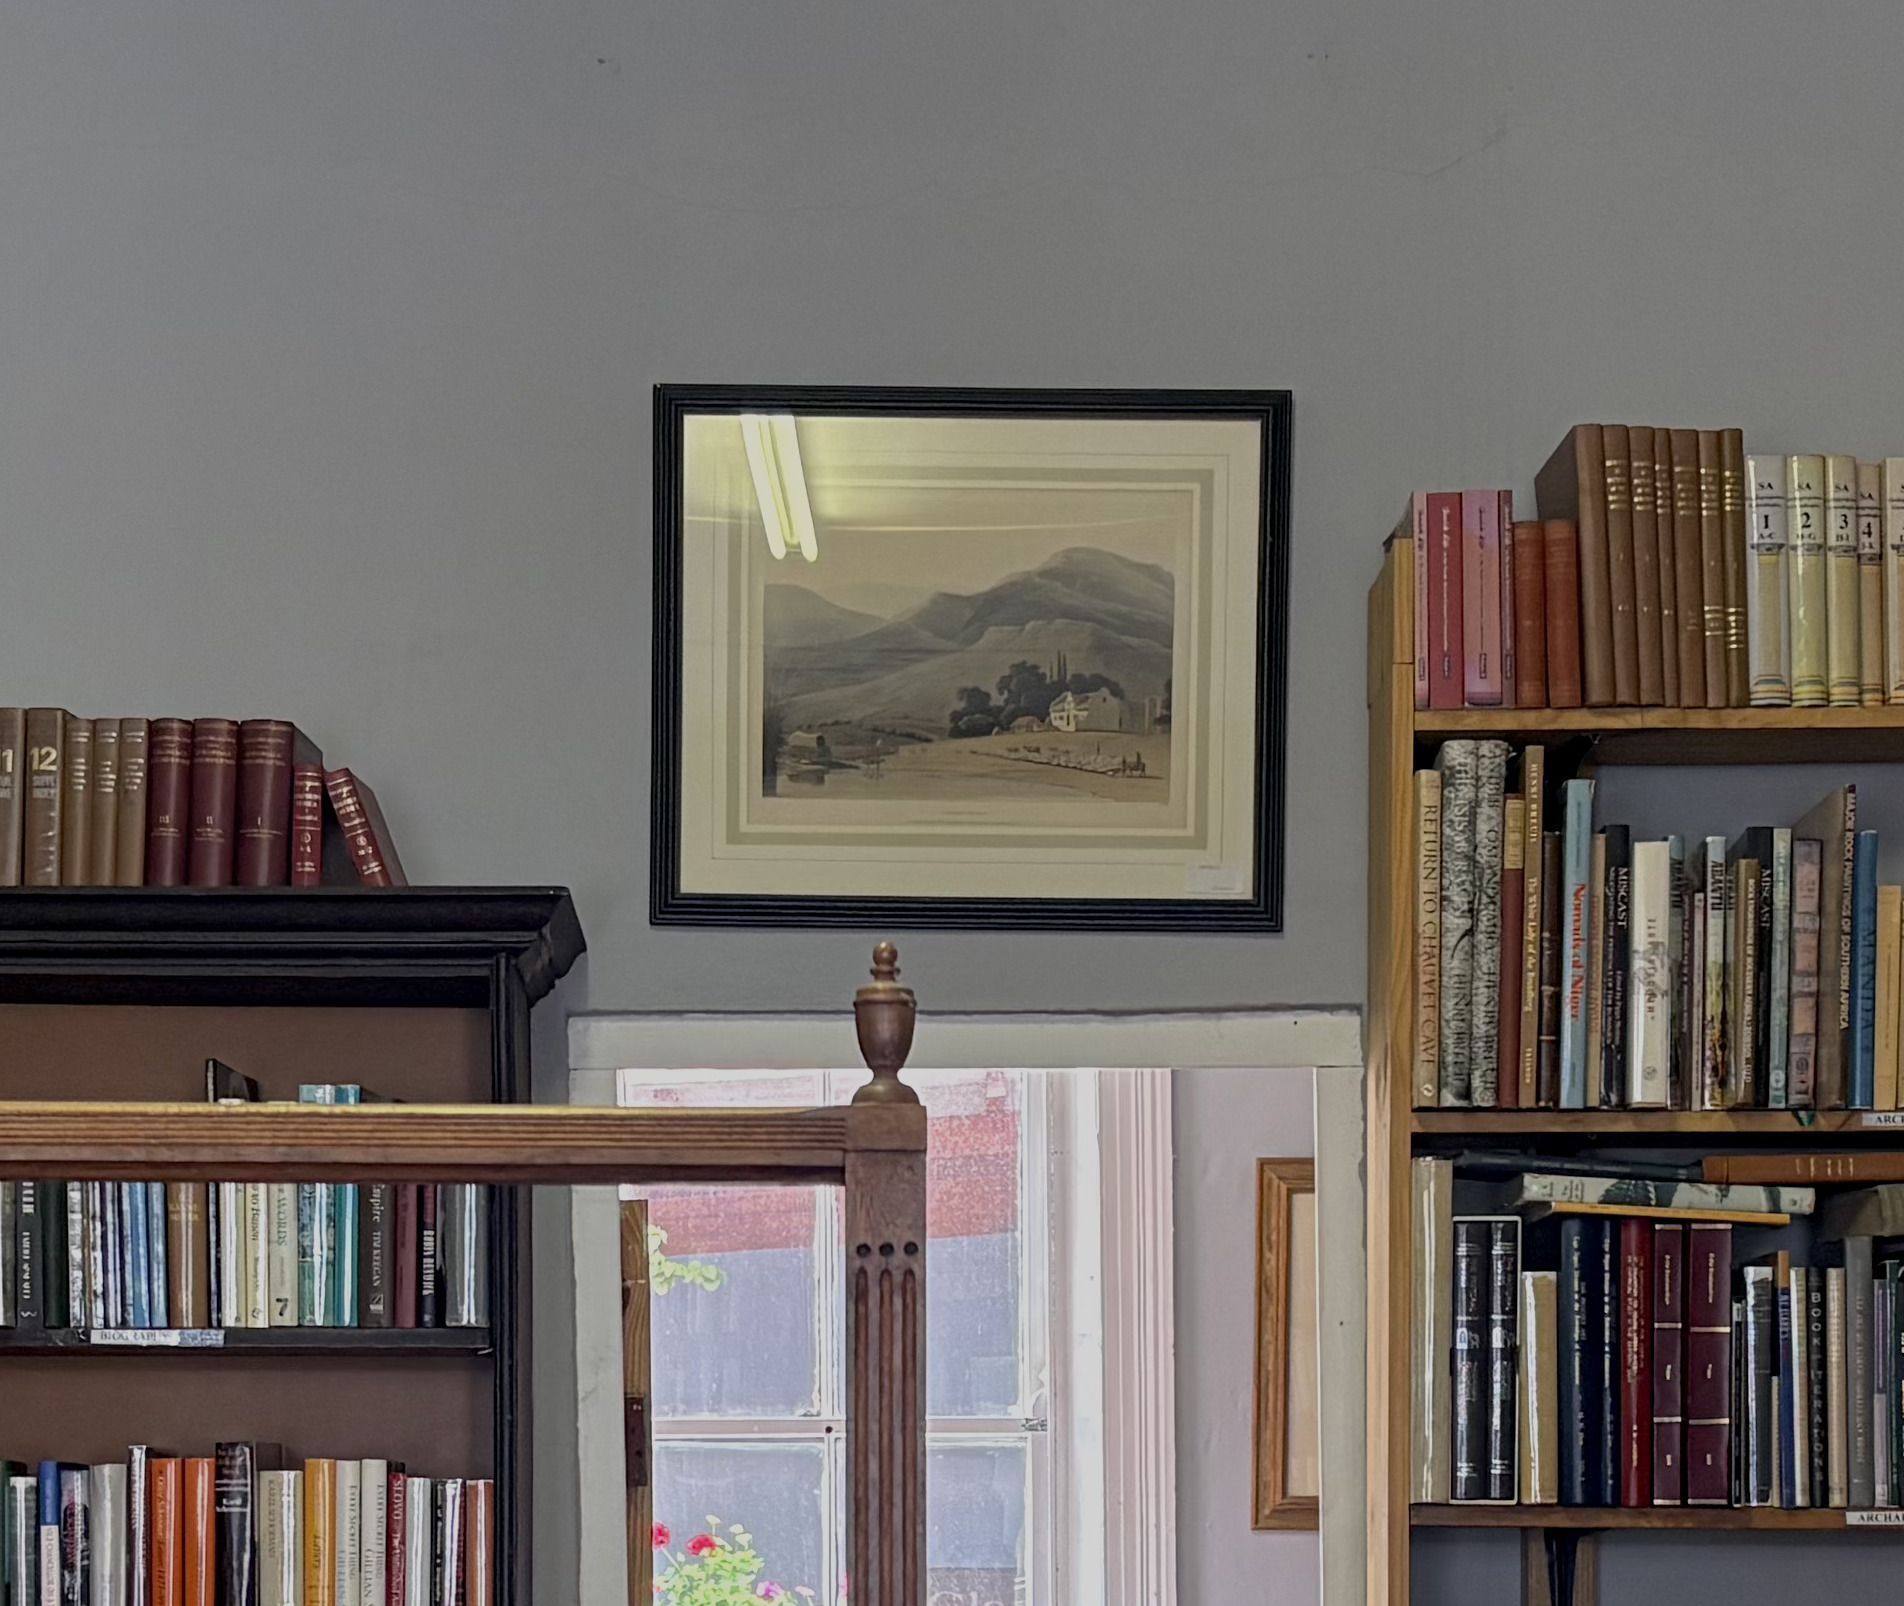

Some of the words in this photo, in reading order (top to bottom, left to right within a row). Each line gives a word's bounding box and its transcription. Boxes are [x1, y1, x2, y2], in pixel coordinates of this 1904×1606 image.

[1758, 482, 1774, 491] SA
[1859, 491, 1873, 500] SA
[1762, 514, 1770, 530] 1
[1801, 512, 1812, 529] 2
[1839, 513, 1849, 530] 3
[1862, 522, 1873, 539] 4
[29, 746, 58, 771] 12
[1844, 793, 1855, 828] MAJOR
[1421, 804, 1437, 886] RETURN
[1842, 832, 1853, 860] ROCK
[1616, 867, 1629, 927] MISCAST
[1840, 861, 1852, 915] PAINTINGS
[1421, 895, 1437, 914] TO
[1570, 883, 1586, 949] Nomads
[1840, 918, 1850, 933] OF
[1421, 921, 1437, 1010] CHAUVET
[1570, 954, 1585, 969] of
[1839, 935, 1850, 990] SOUTHERN
[1565, 976, 1584, 1021] Niger
[1838, 991, 1848, 1029] AFRICA
[361, 1548, 374, 1598] GILLIAN
